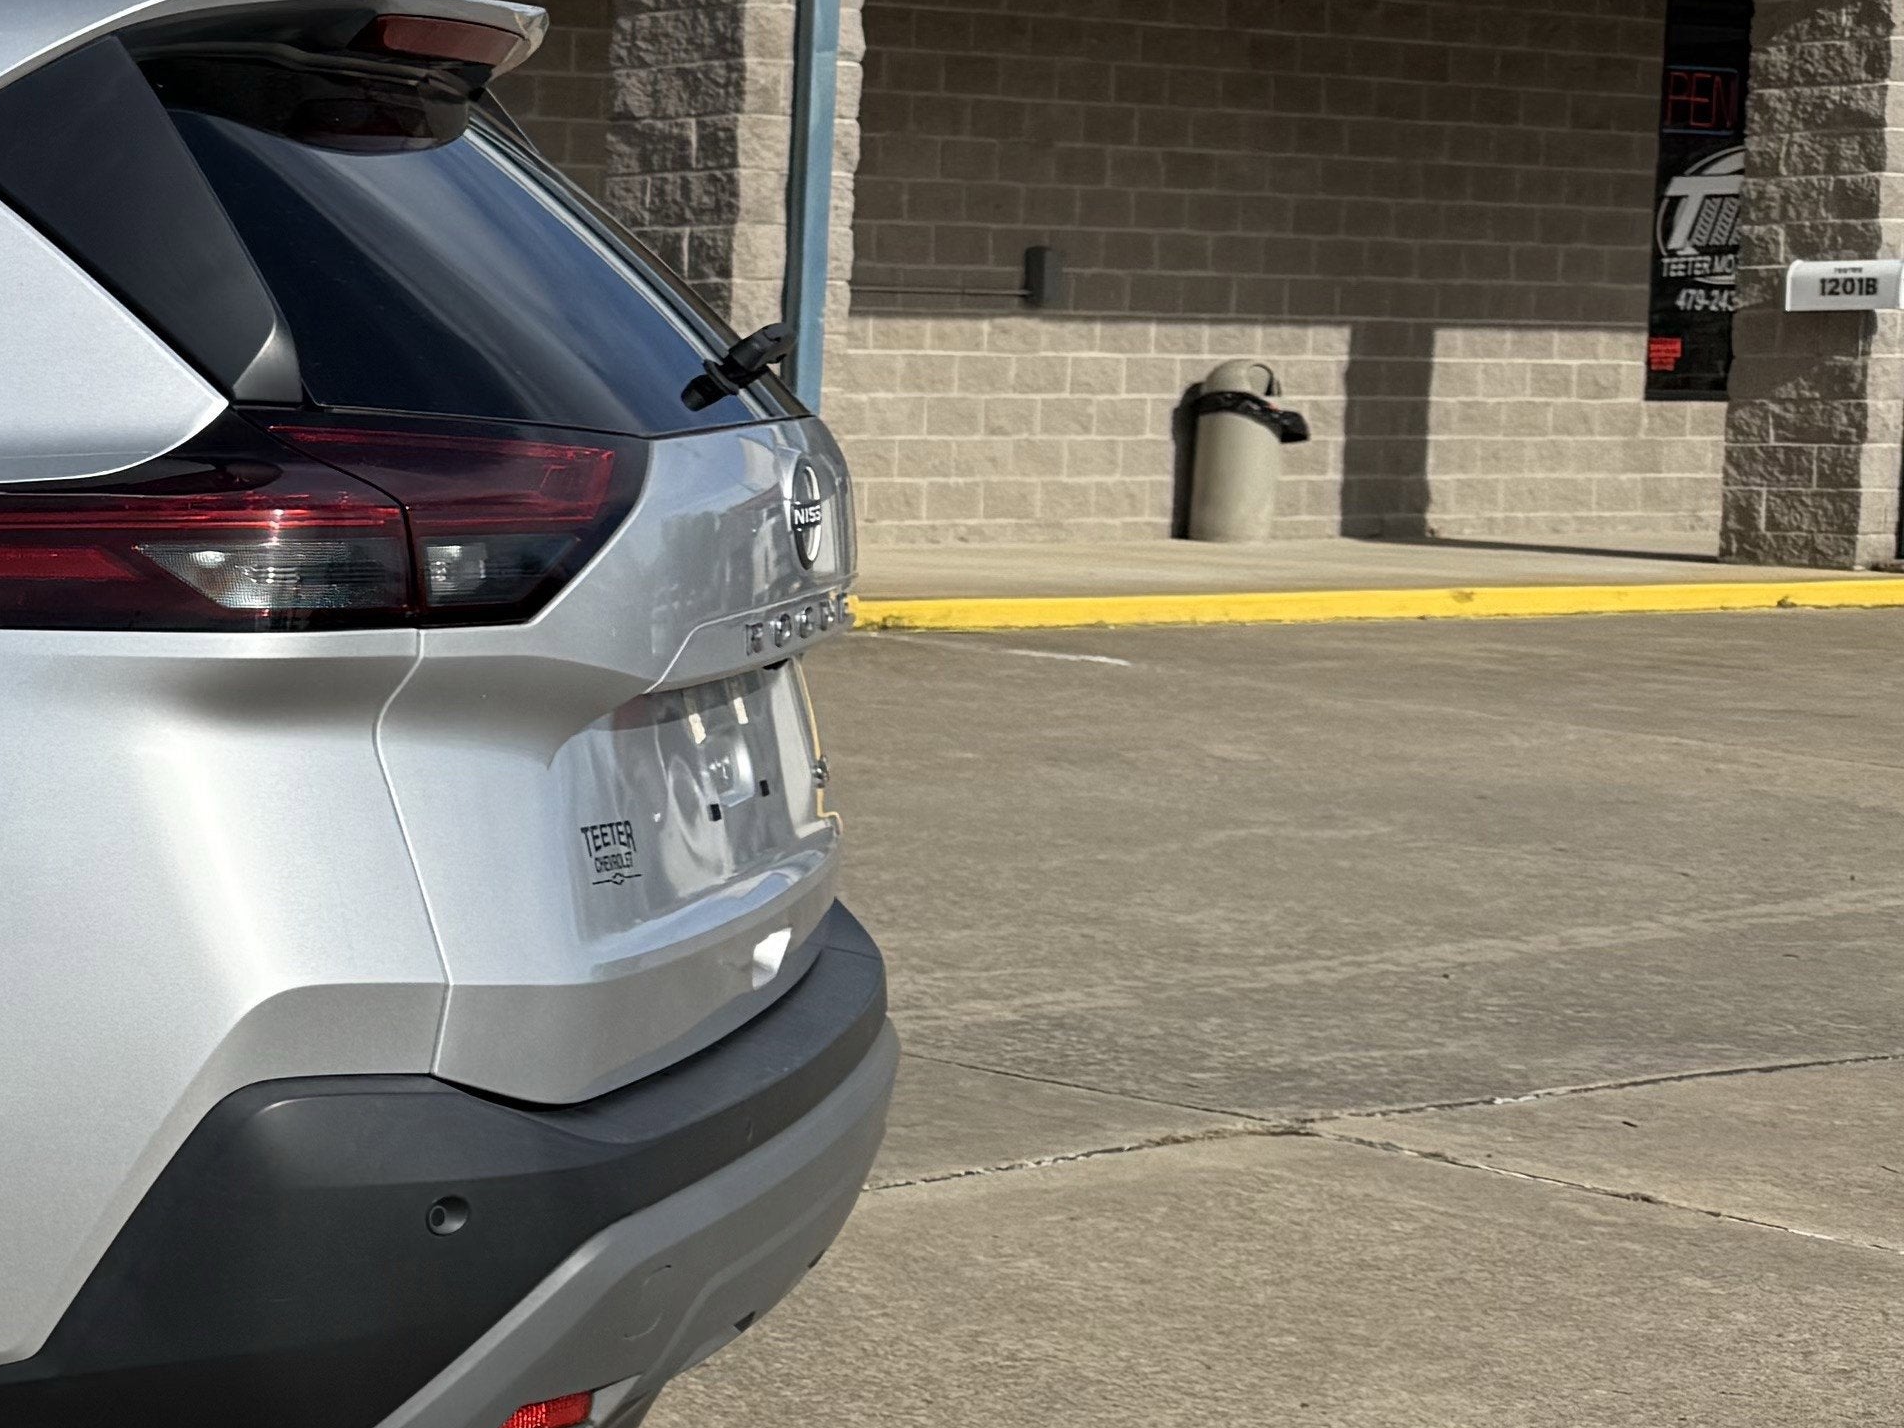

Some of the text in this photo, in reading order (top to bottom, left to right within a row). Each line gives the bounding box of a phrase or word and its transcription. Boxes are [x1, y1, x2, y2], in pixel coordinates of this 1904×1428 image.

[1664, 72, 1737, 127] PEN
[1661, 255, 1712, 278] TEETER
[1819, 276, 1879, 297] 1201B
[794, 504, 822, 526] NISS
[580, 820, 637, 859] TEETER
